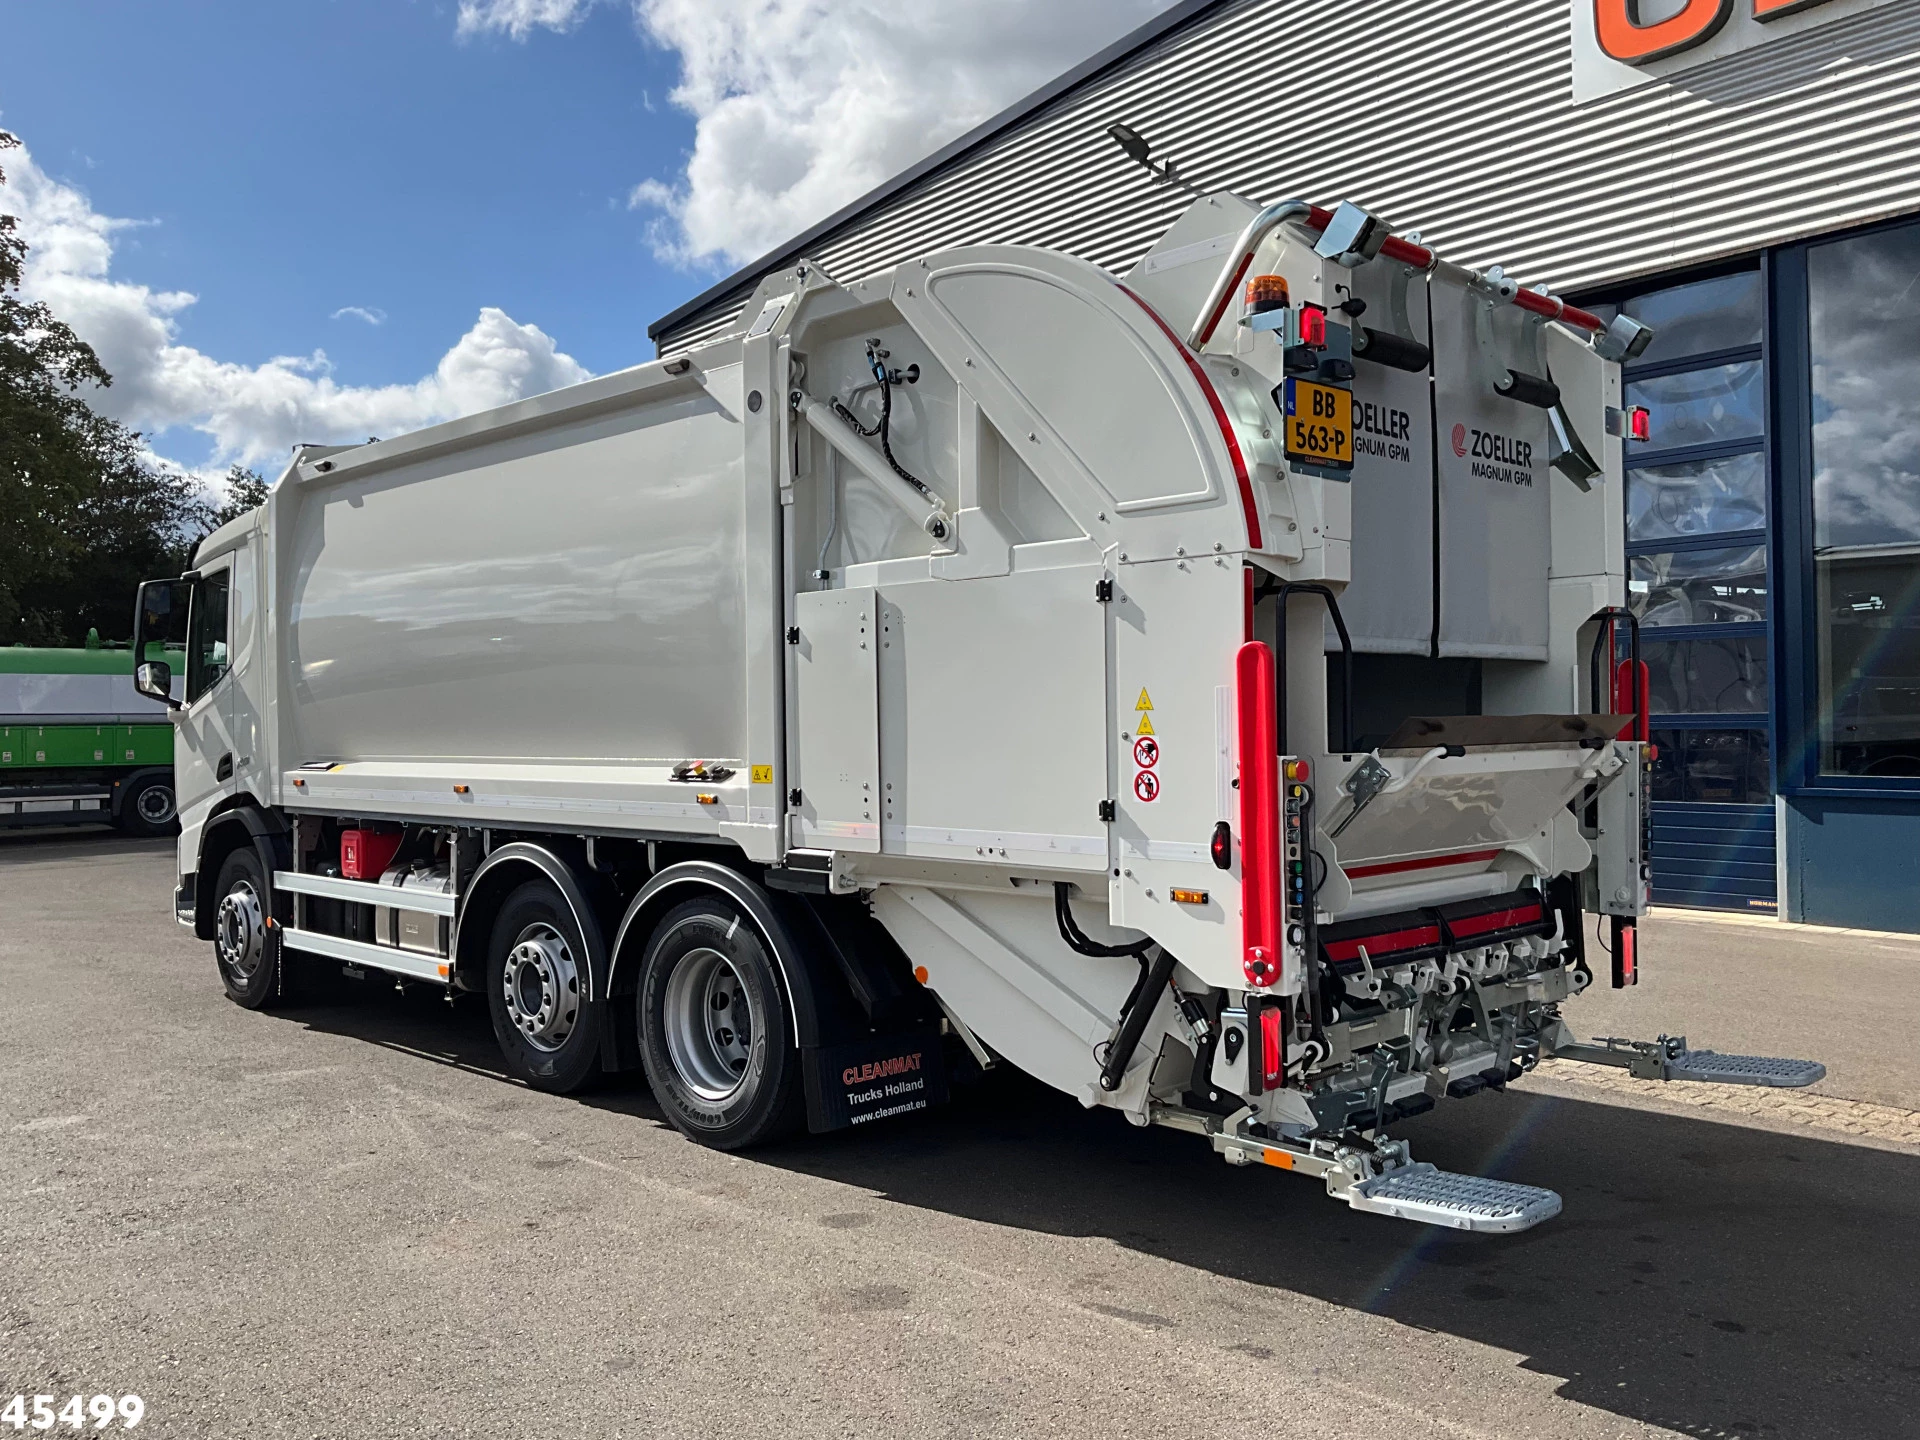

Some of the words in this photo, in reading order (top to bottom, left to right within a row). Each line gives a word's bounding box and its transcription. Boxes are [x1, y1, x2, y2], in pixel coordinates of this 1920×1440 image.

[1287, 400, 1295, 411] NL
[1313, 389, 1336, 419] BB
[1352, 399, 1410, 442] OELLER
[1296, 422, 1346, 455] 563-P
[1354, 436, 1386, 458] GNUM
[1388, 443, 1410, 463] GPM
[1471, 429, 1532, 469] ZOELLER
[1471, 461, 1512, 484] MAGNUM
[1514, 470, 1532, 488] GPM
[842, 1053, 922, 1086] CLEANMAT
[847, 1088, 883, 1106] Trucks
[885, 1077, 925, 1097] Holland
[850, 1099, 927, 1125] www.cleanmat.eu
